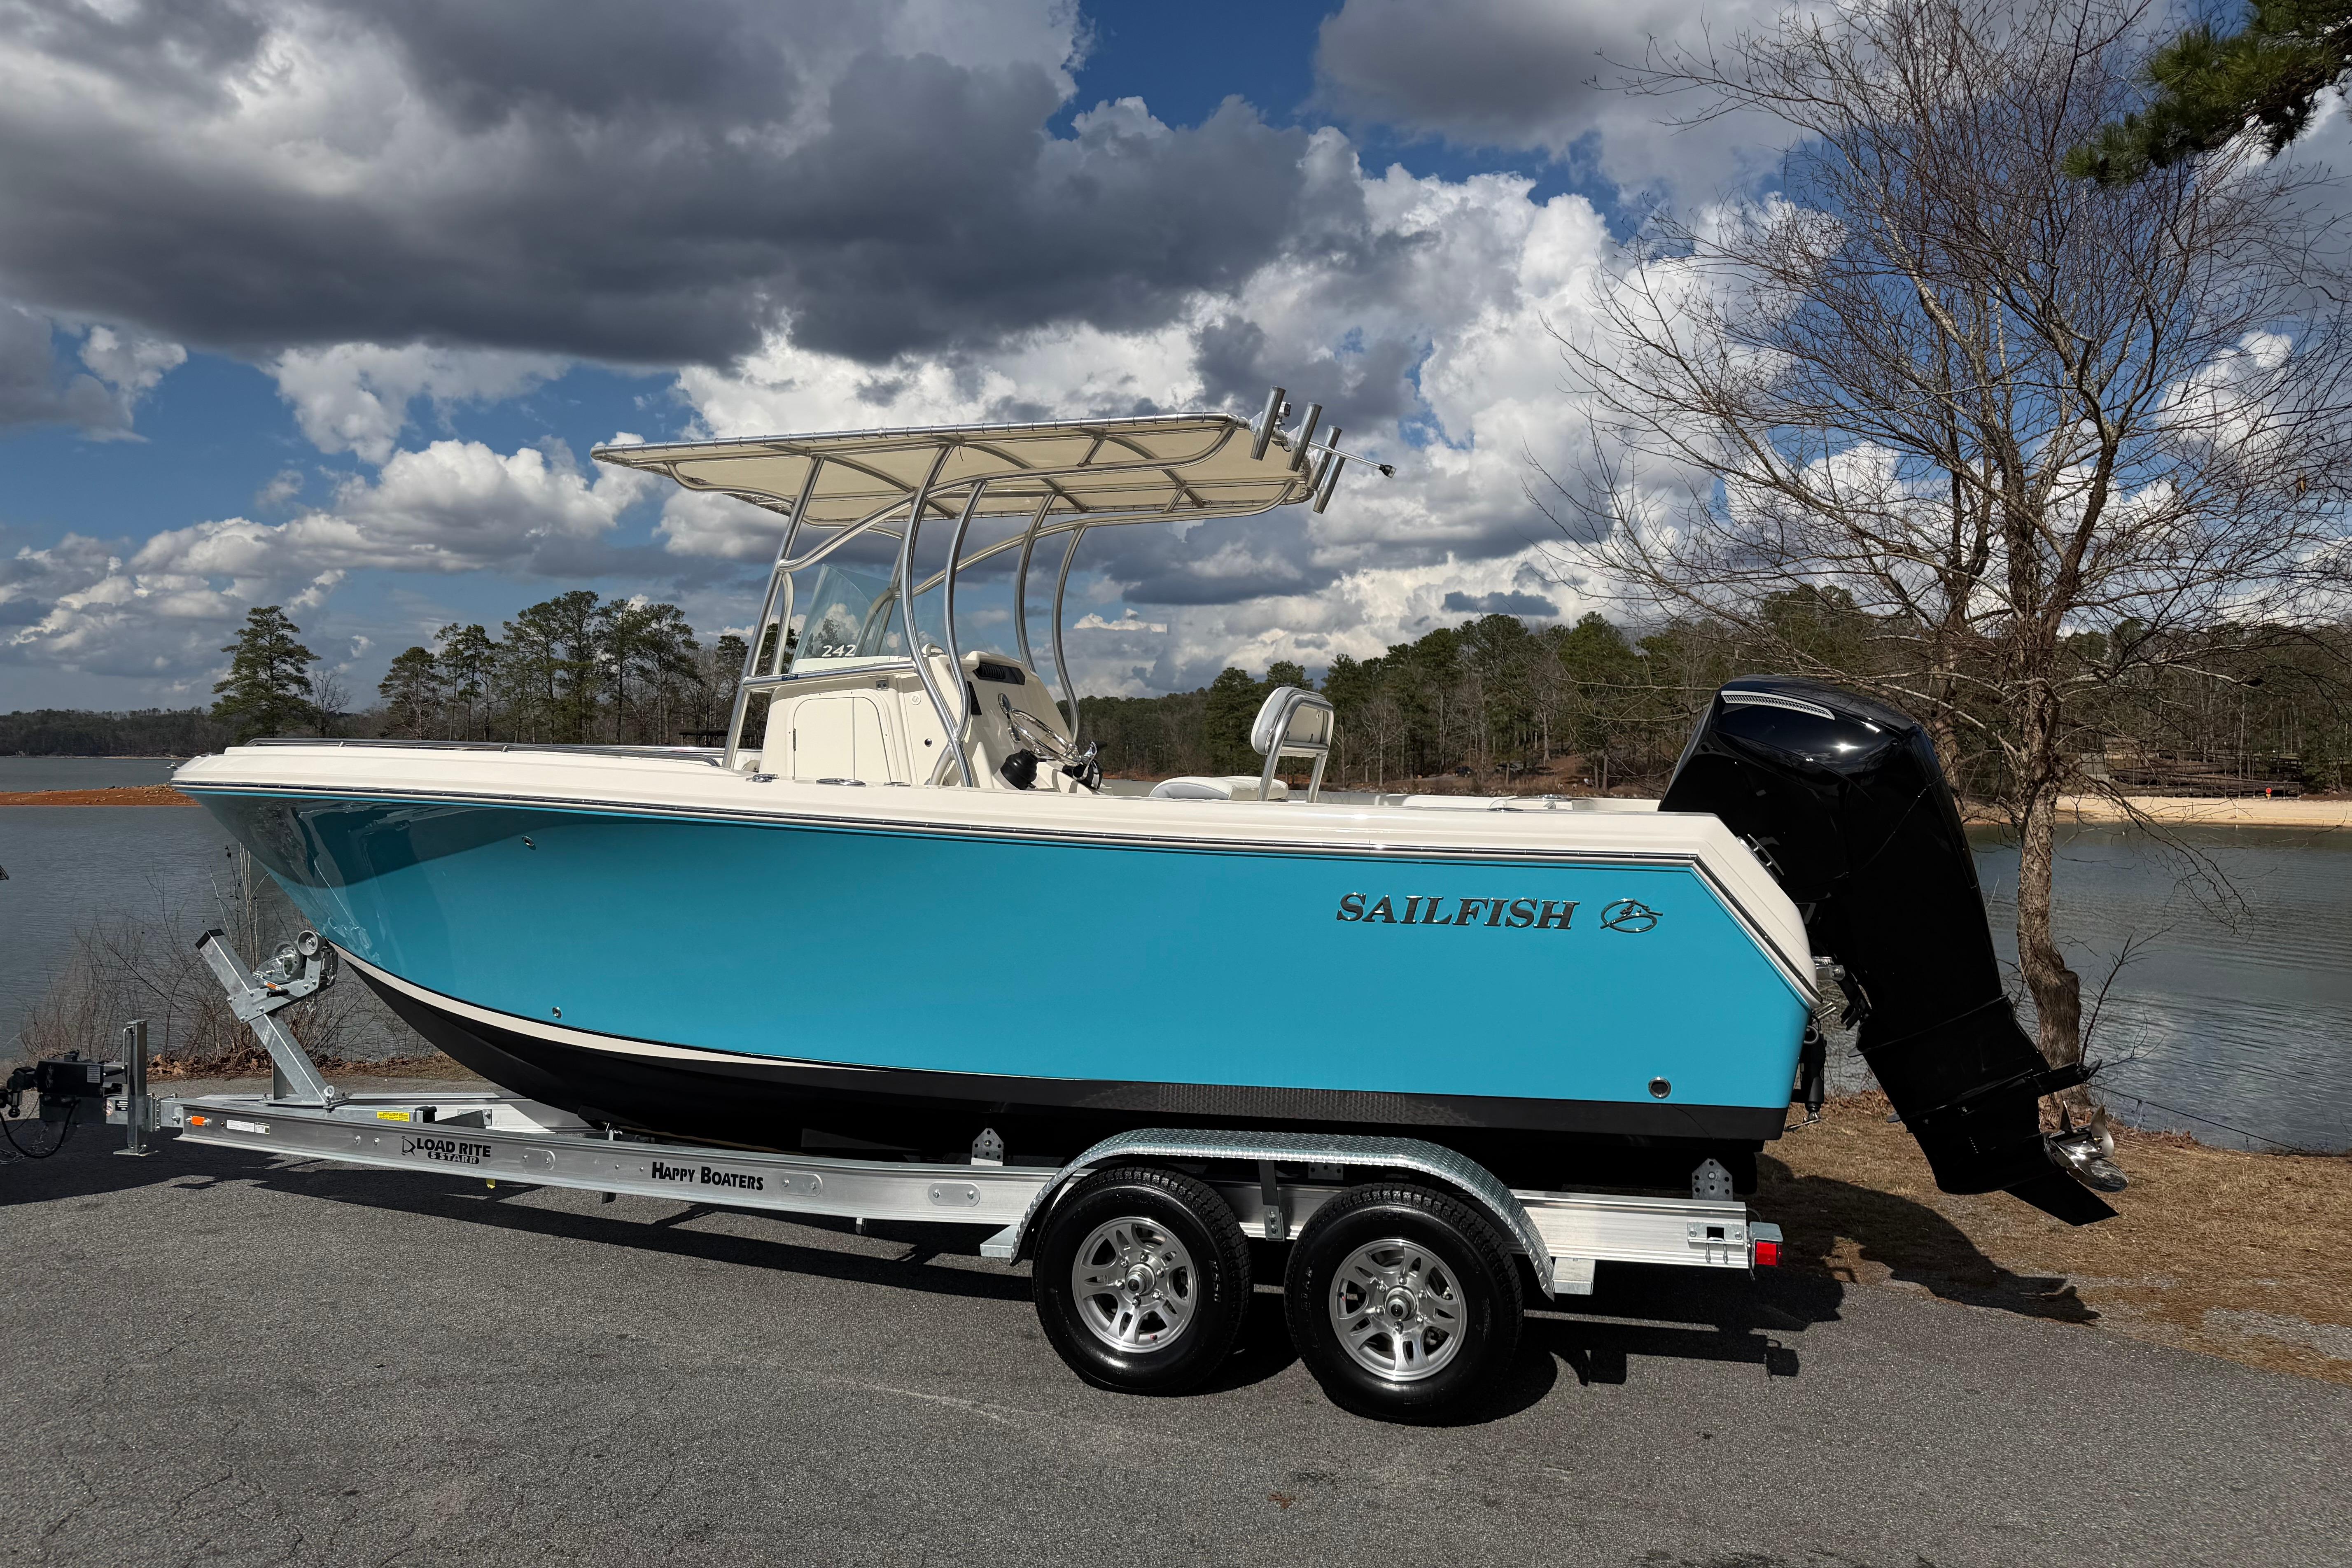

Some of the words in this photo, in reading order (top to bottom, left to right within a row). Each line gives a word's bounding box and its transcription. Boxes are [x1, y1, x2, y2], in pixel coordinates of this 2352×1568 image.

[821, 644, 856, 657] 242
[1336, 892, 1580, 930] SAILFISH
[417, 1138, 455, 1153] LOAD
[459, 1142, 491, 1157] RITE
[439, 1153, 477, 1164] STARR
